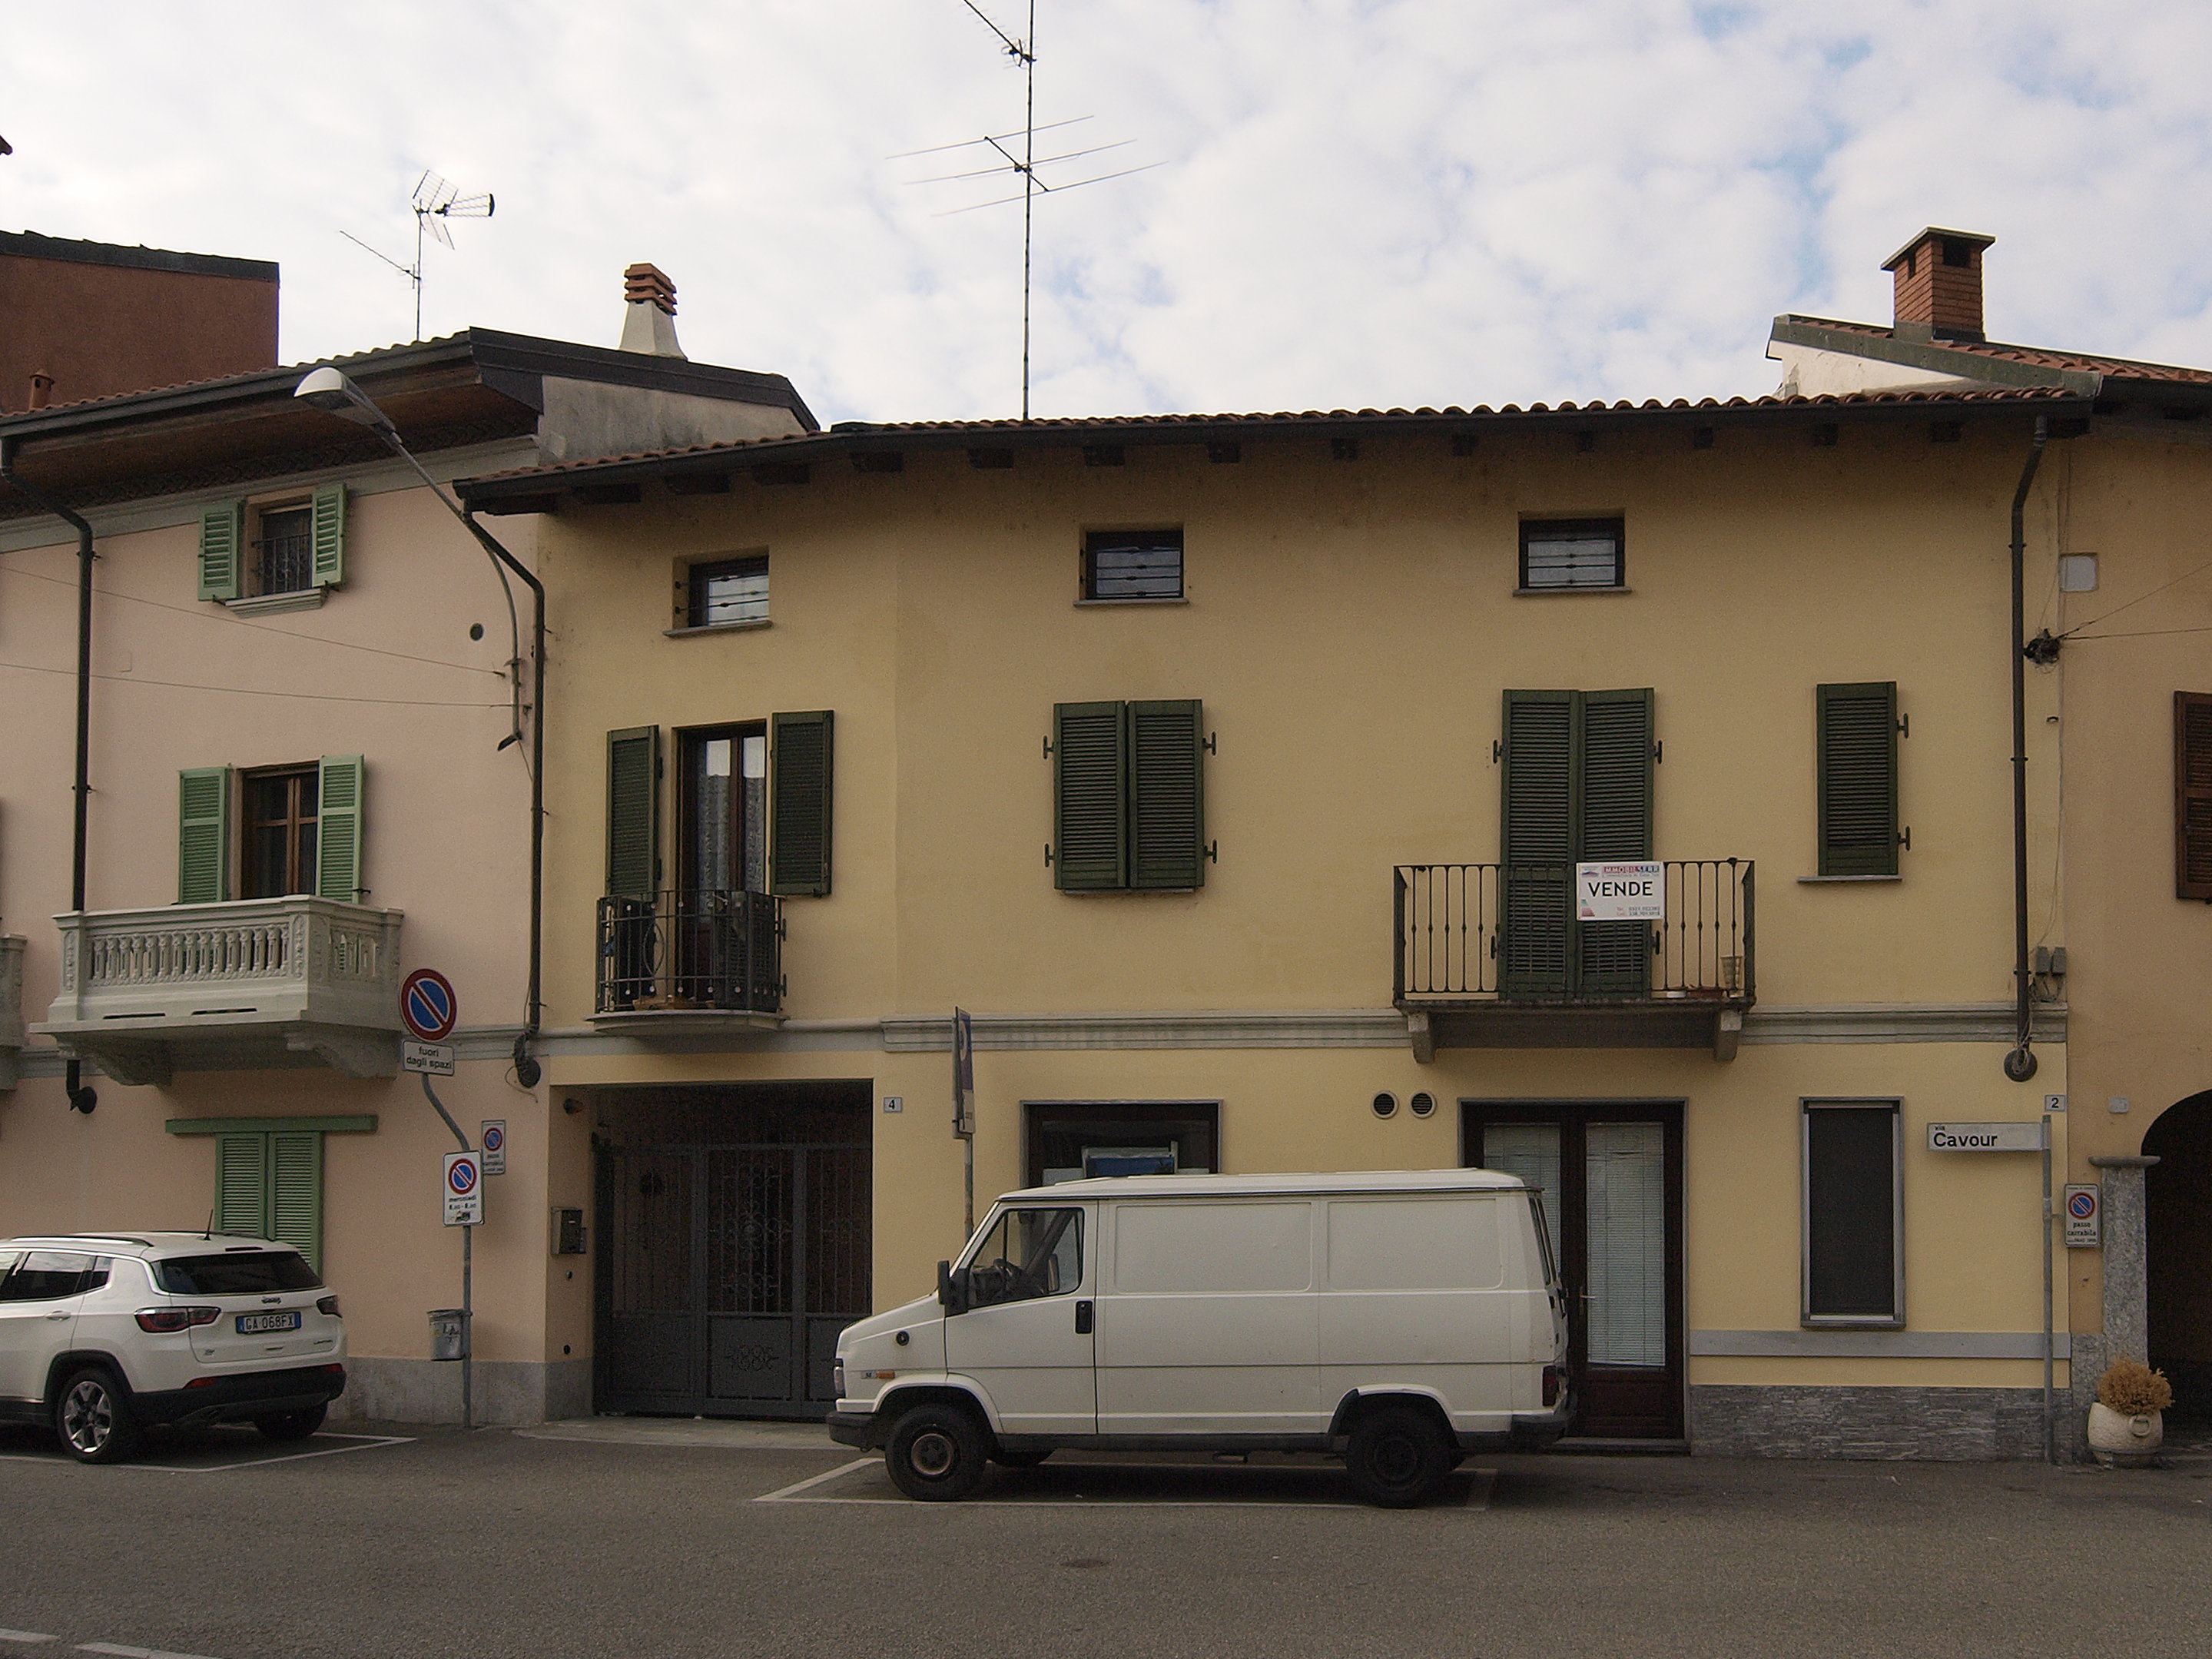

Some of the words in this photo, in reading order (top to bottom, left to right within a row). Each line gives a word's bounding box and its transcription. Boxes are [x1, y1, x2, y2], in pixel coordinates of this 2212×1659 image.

[1588, 881, 1653, 897] VENDE
[419, 1046, 439, 1057] fuori
[888, 1099, 895, 1110] 4
[2051, 1097, 2059, 1108] 2
[1933, 1132, 1998, 1147] Cavour
[245, 1318, 259, 1330] GA
[261, 1314, 293, 1329] 068FX
